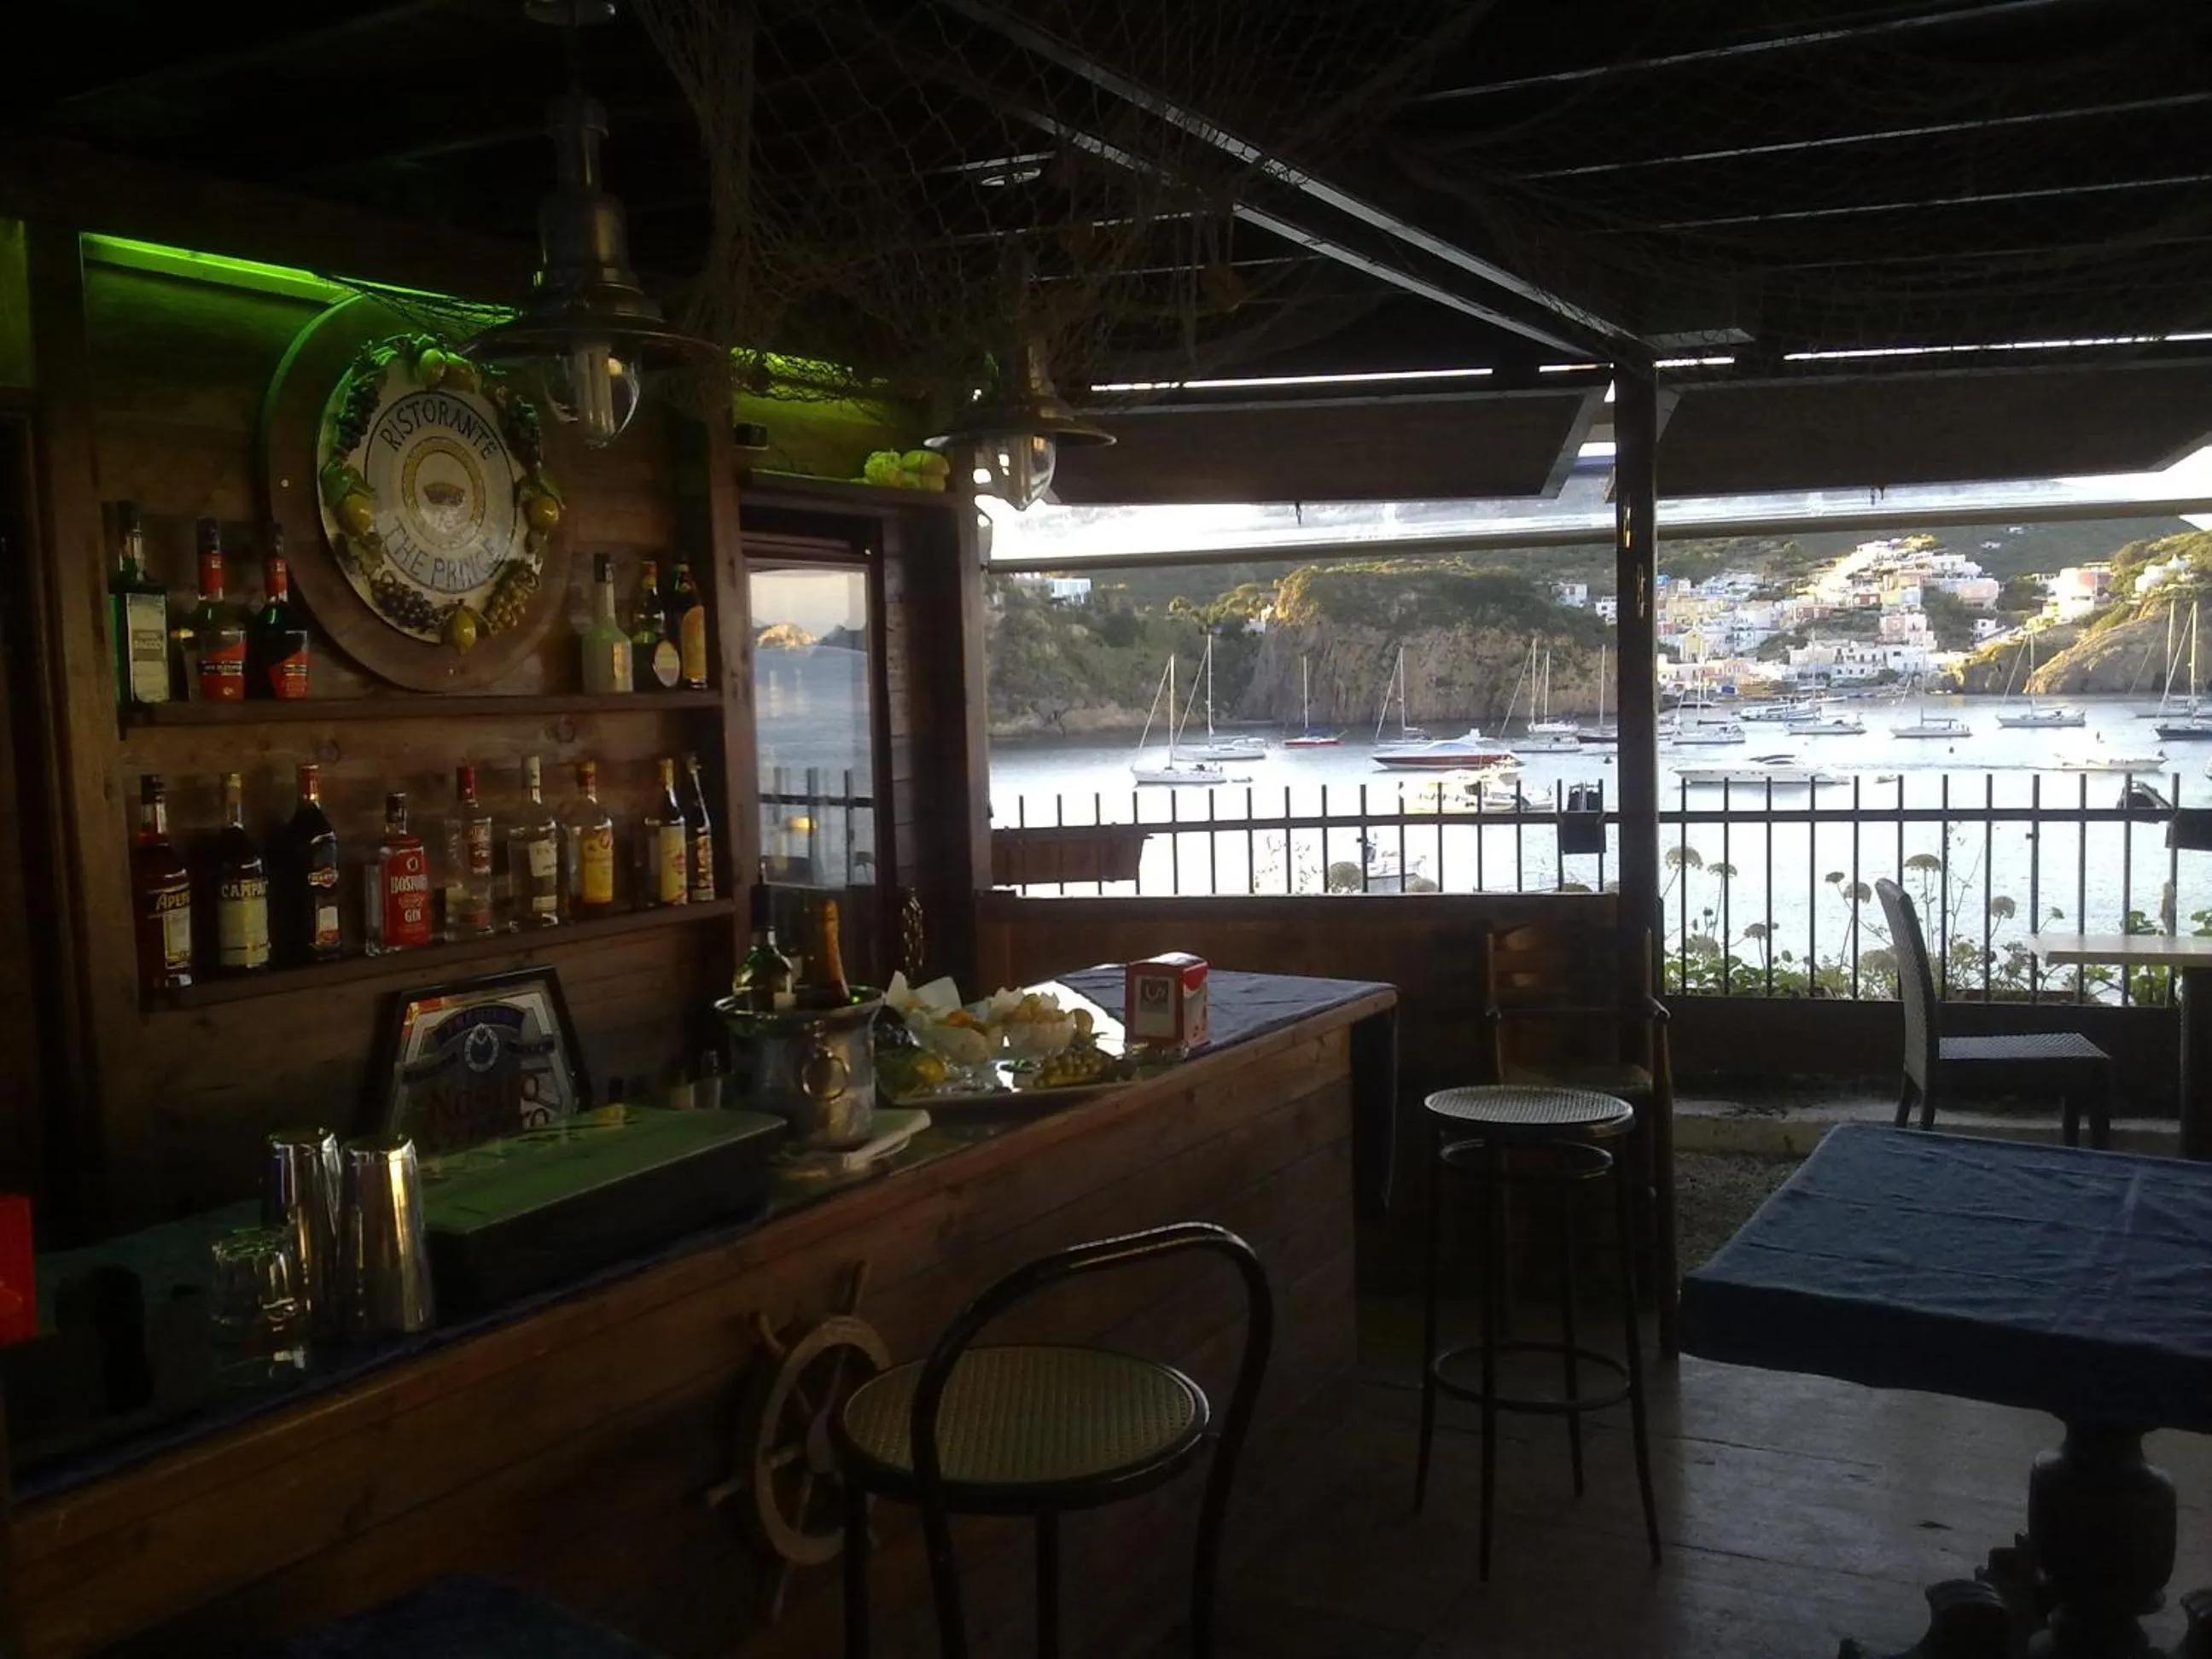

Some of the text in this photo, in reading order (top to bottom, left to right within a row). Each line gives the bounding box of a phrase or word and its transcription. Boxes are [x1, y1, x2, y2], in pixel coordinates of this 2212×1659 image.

[379, 399, 498, 460] RISTORANTE
[384, 515, 503, 590] THE PRINCE
